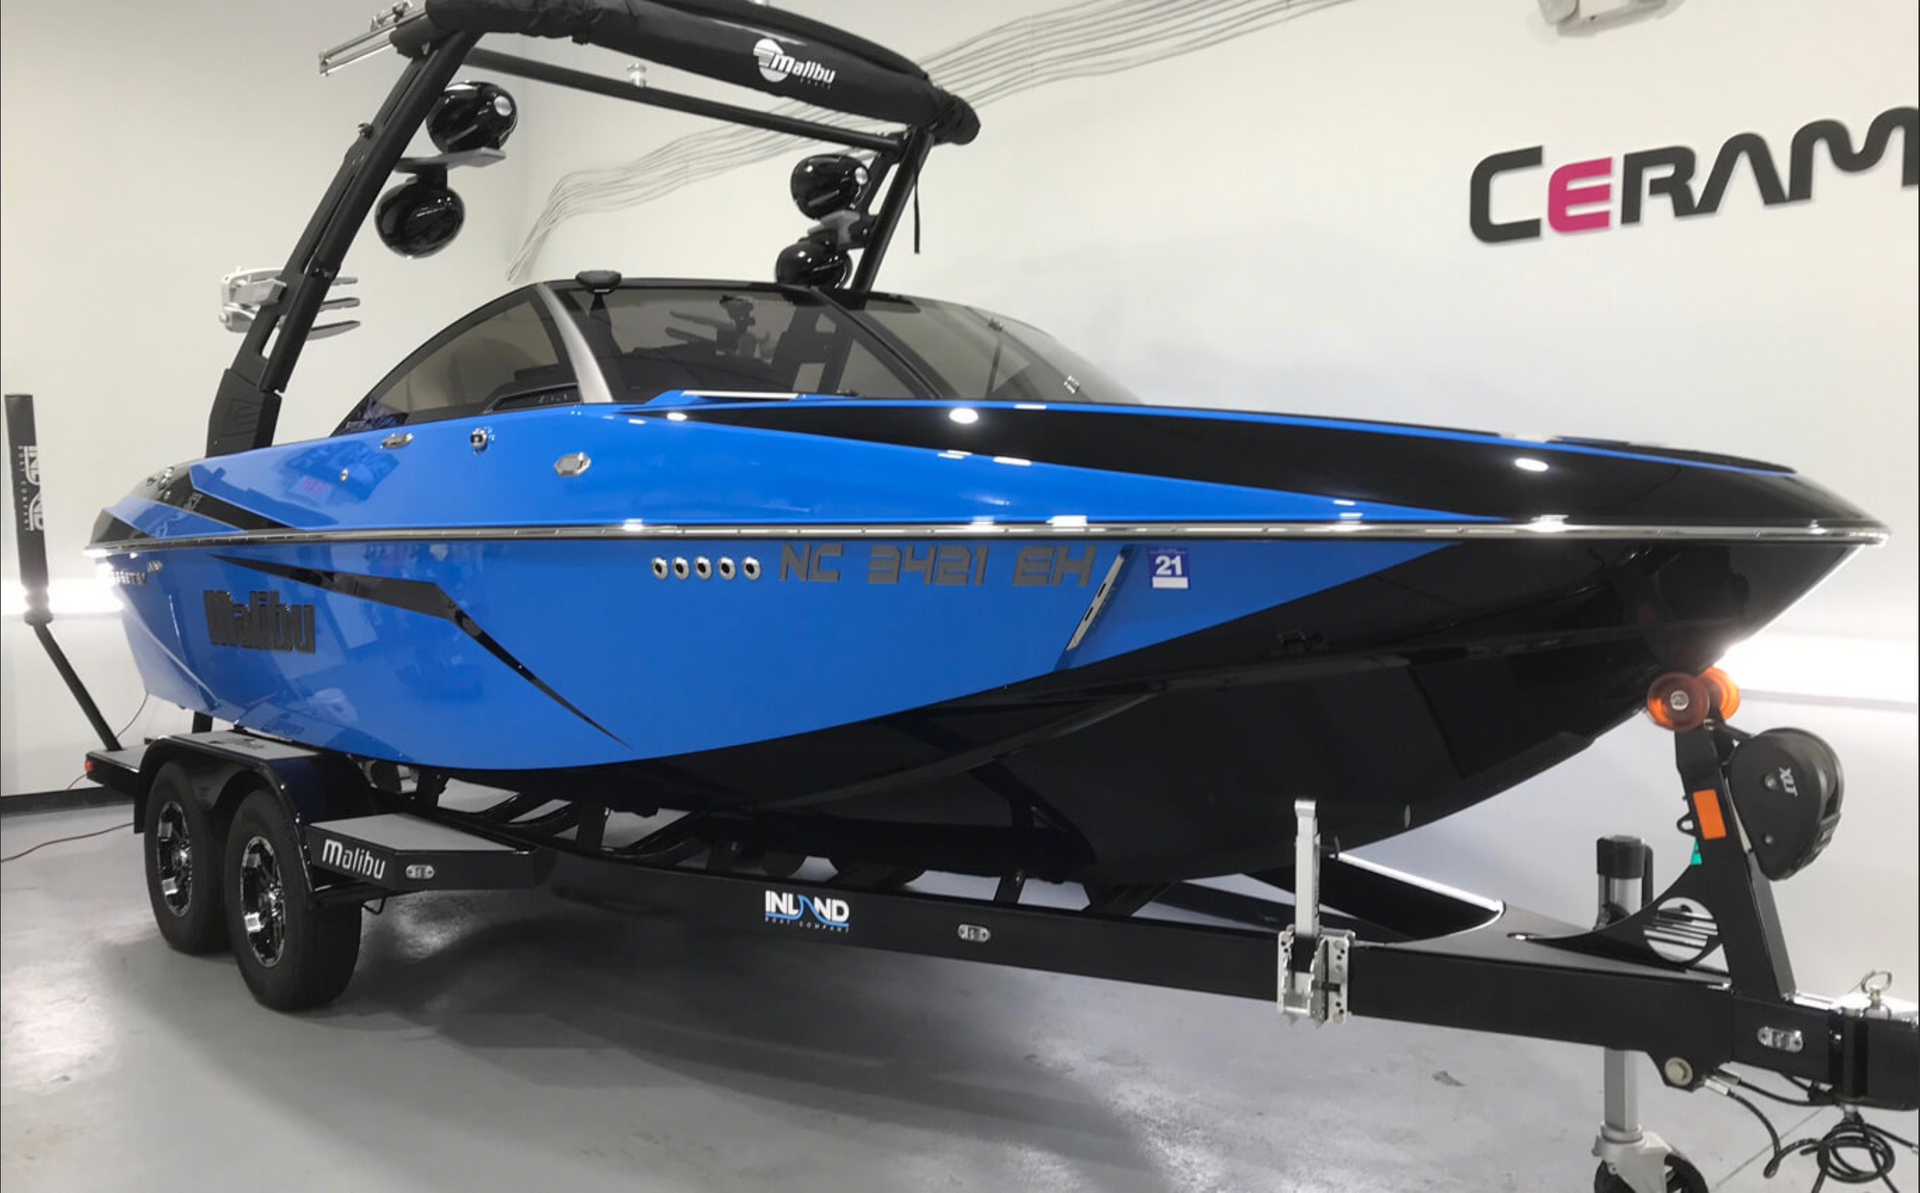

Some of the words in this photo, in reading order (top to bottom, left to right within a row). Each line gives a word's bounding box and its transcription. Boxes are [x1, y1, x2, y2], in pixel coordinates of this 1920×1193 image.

[779, 543, 844, 582] NC
[866, 544, 990, 586] 3421
[1011, 544, 1097, 586] EH
[1155, 554, 1182, 576] 21
[1779, 766, 1798, 797] XLT
[321, 838, 386, 880] Malibu
[765, 888, 850, 926] INLAND
